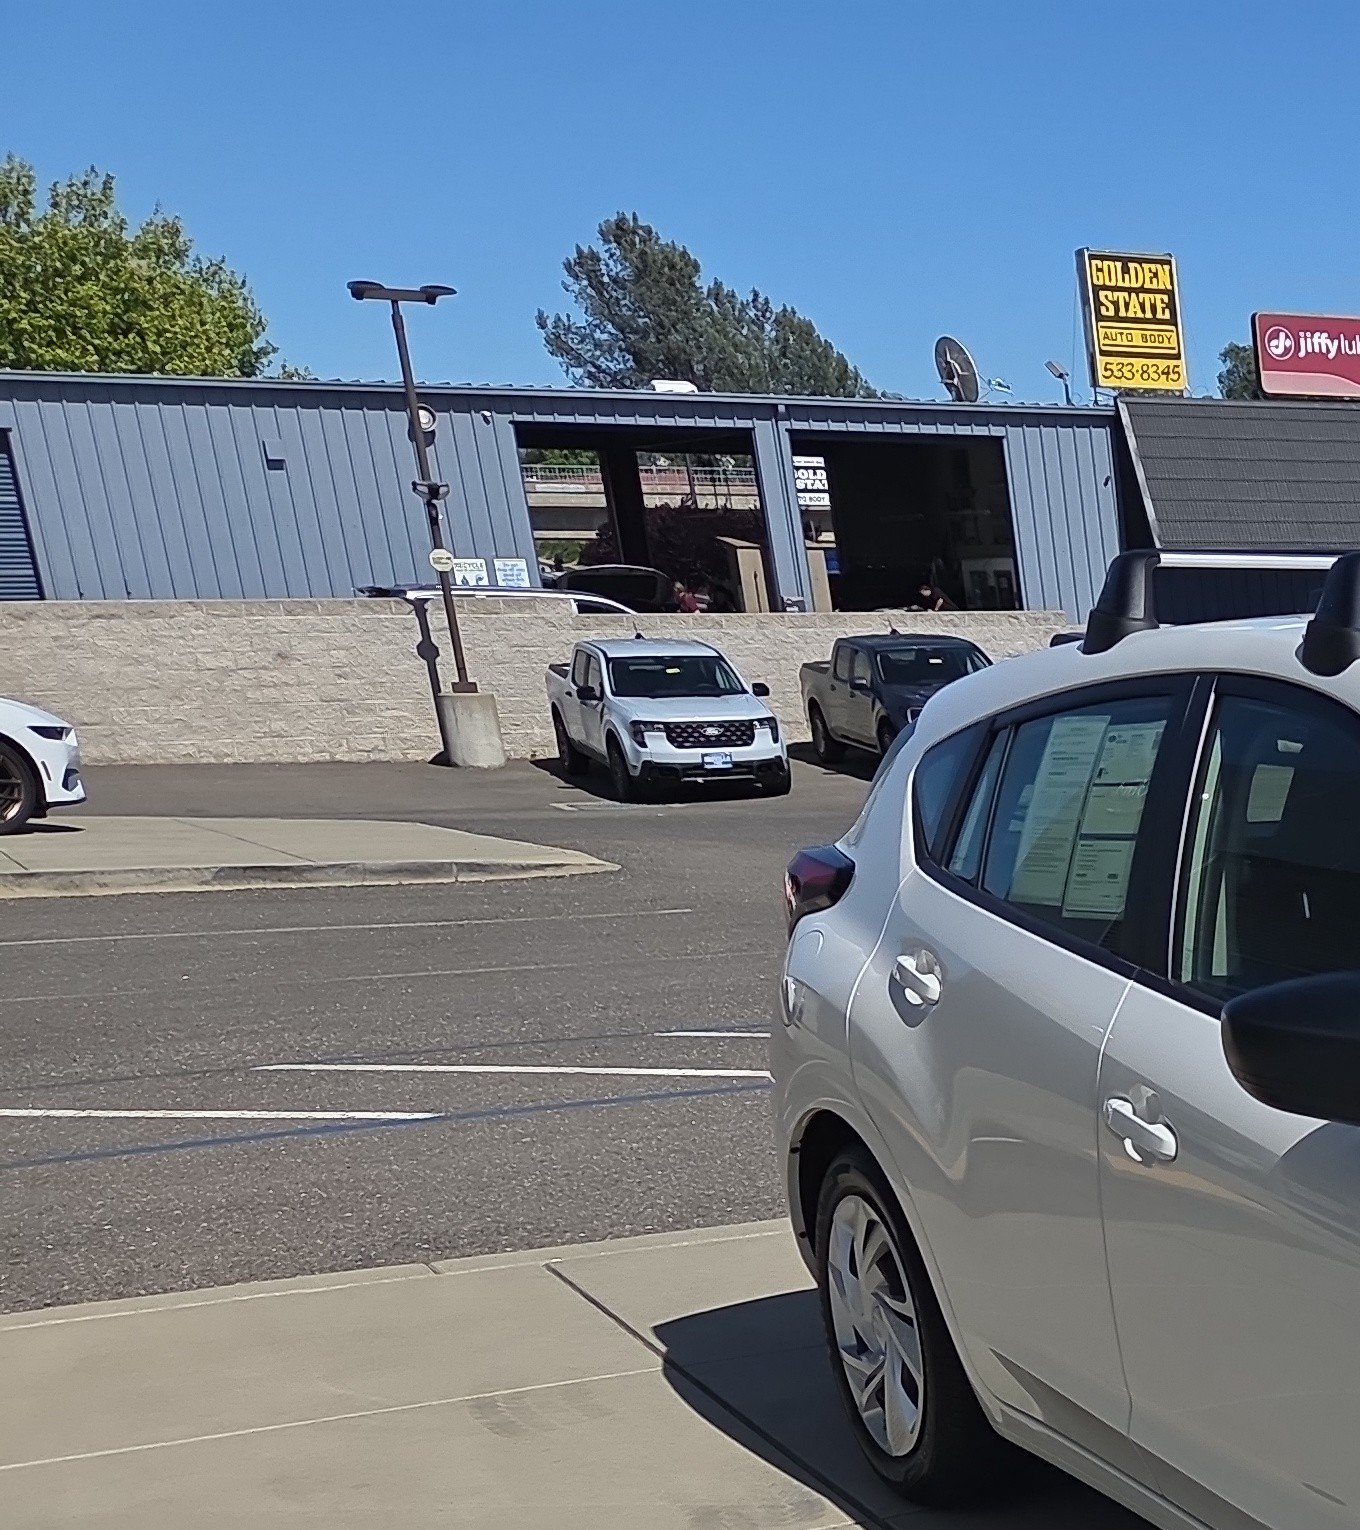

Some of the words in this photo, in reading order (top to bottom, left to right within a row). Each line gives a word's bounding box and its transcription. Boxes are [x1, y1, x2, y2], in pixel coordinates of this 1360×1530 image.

[1091, 260, 1172, 290] GOLDEN
[1099, 290, 1171, 319] STATE
[1103, 331, 1134, 342] AUTO
[1141, 334, 1173, 344] BODY
[1298, 331, 1339, 359] jiffy
